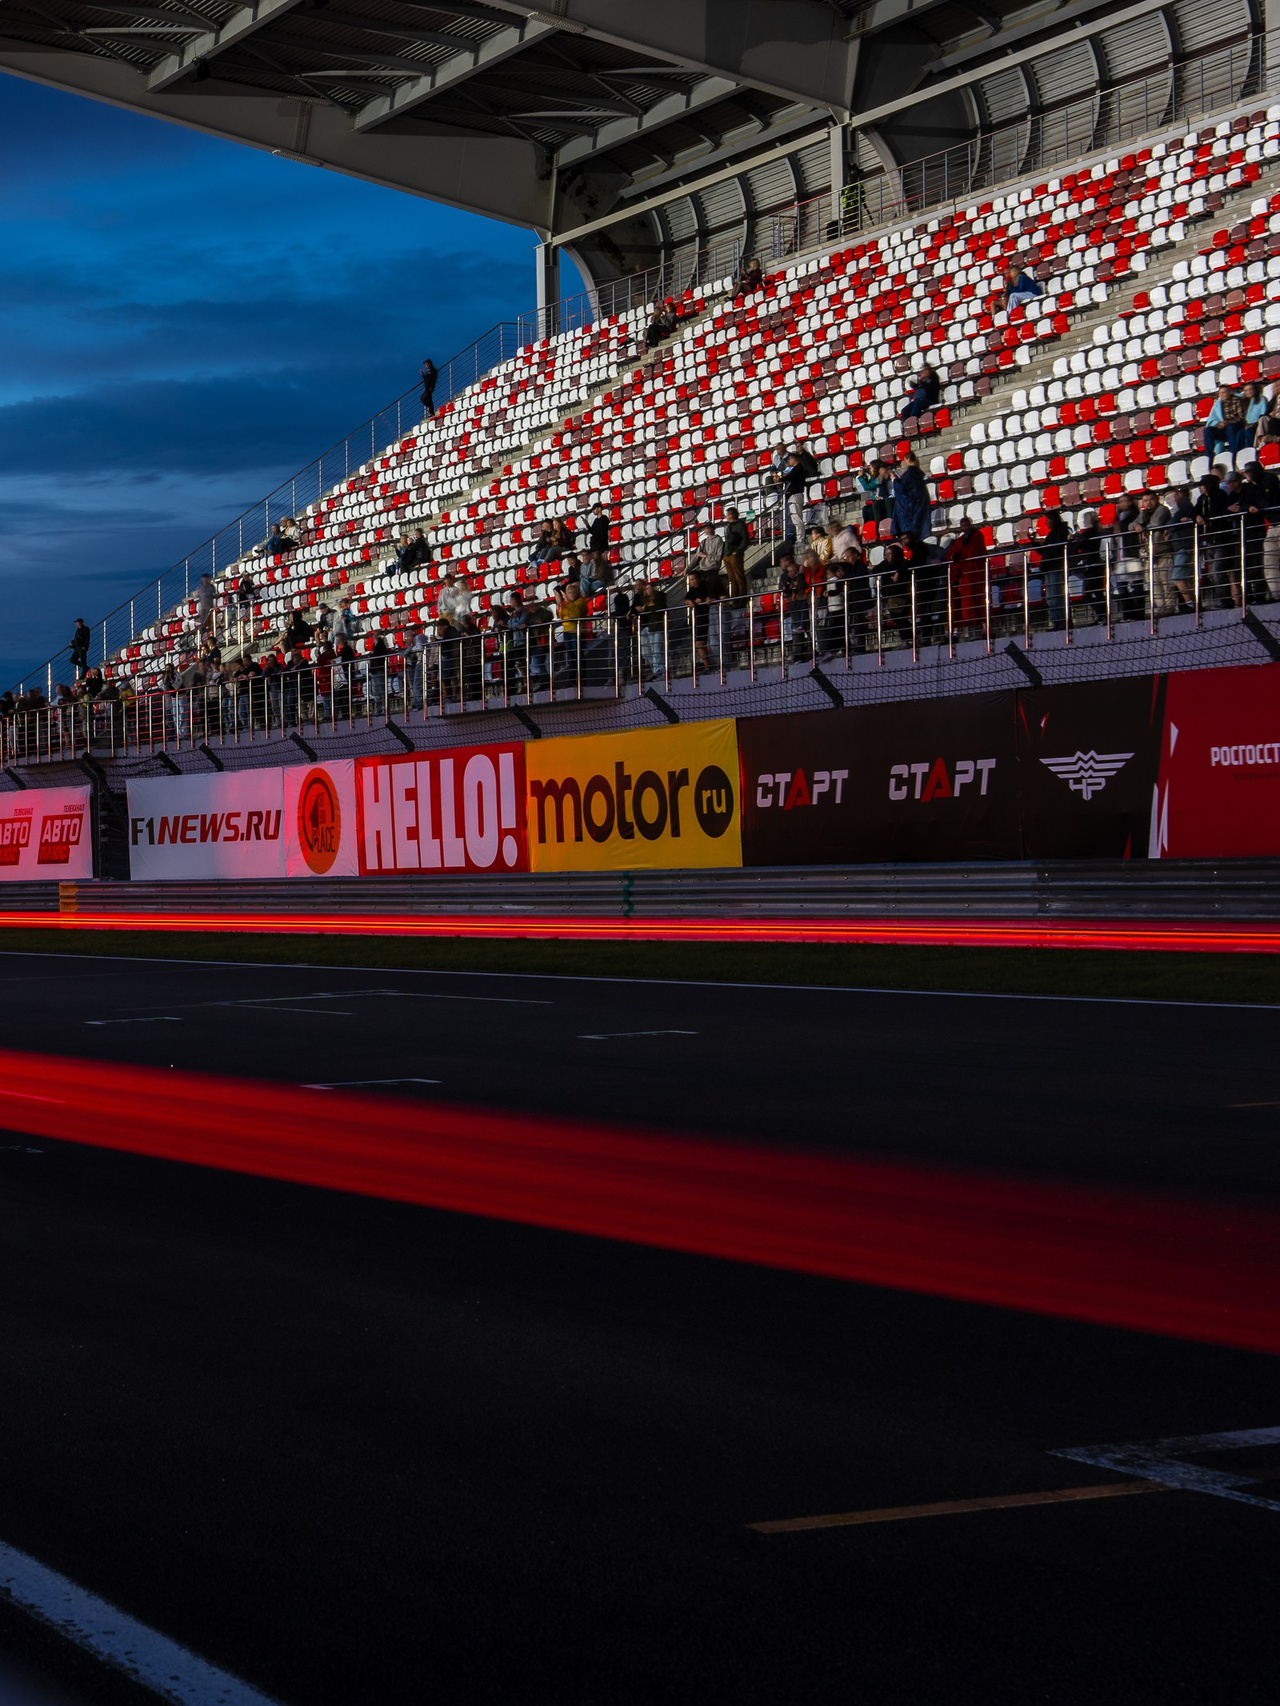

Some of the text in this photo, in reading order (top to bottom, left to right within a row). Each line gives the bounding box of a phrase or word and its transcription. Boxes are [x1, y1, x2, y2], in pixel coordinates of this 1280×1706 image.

[1210, 742, 1280, 767] РОСГОССТ
[756, 767, 849, 810] СТАРТ
[889, 757, 996, 803] СТАРТ
[362, 752, 518, 870] HELLO!
[530, 761, 727, 844] motor ru
[41, 818, 80, 843] АВТО
[130, 809, 282, 846] F1NEWS.RU
[312, 827, 336, 853] PLACE
[39, 846, 67, 861] ПЛЮС
